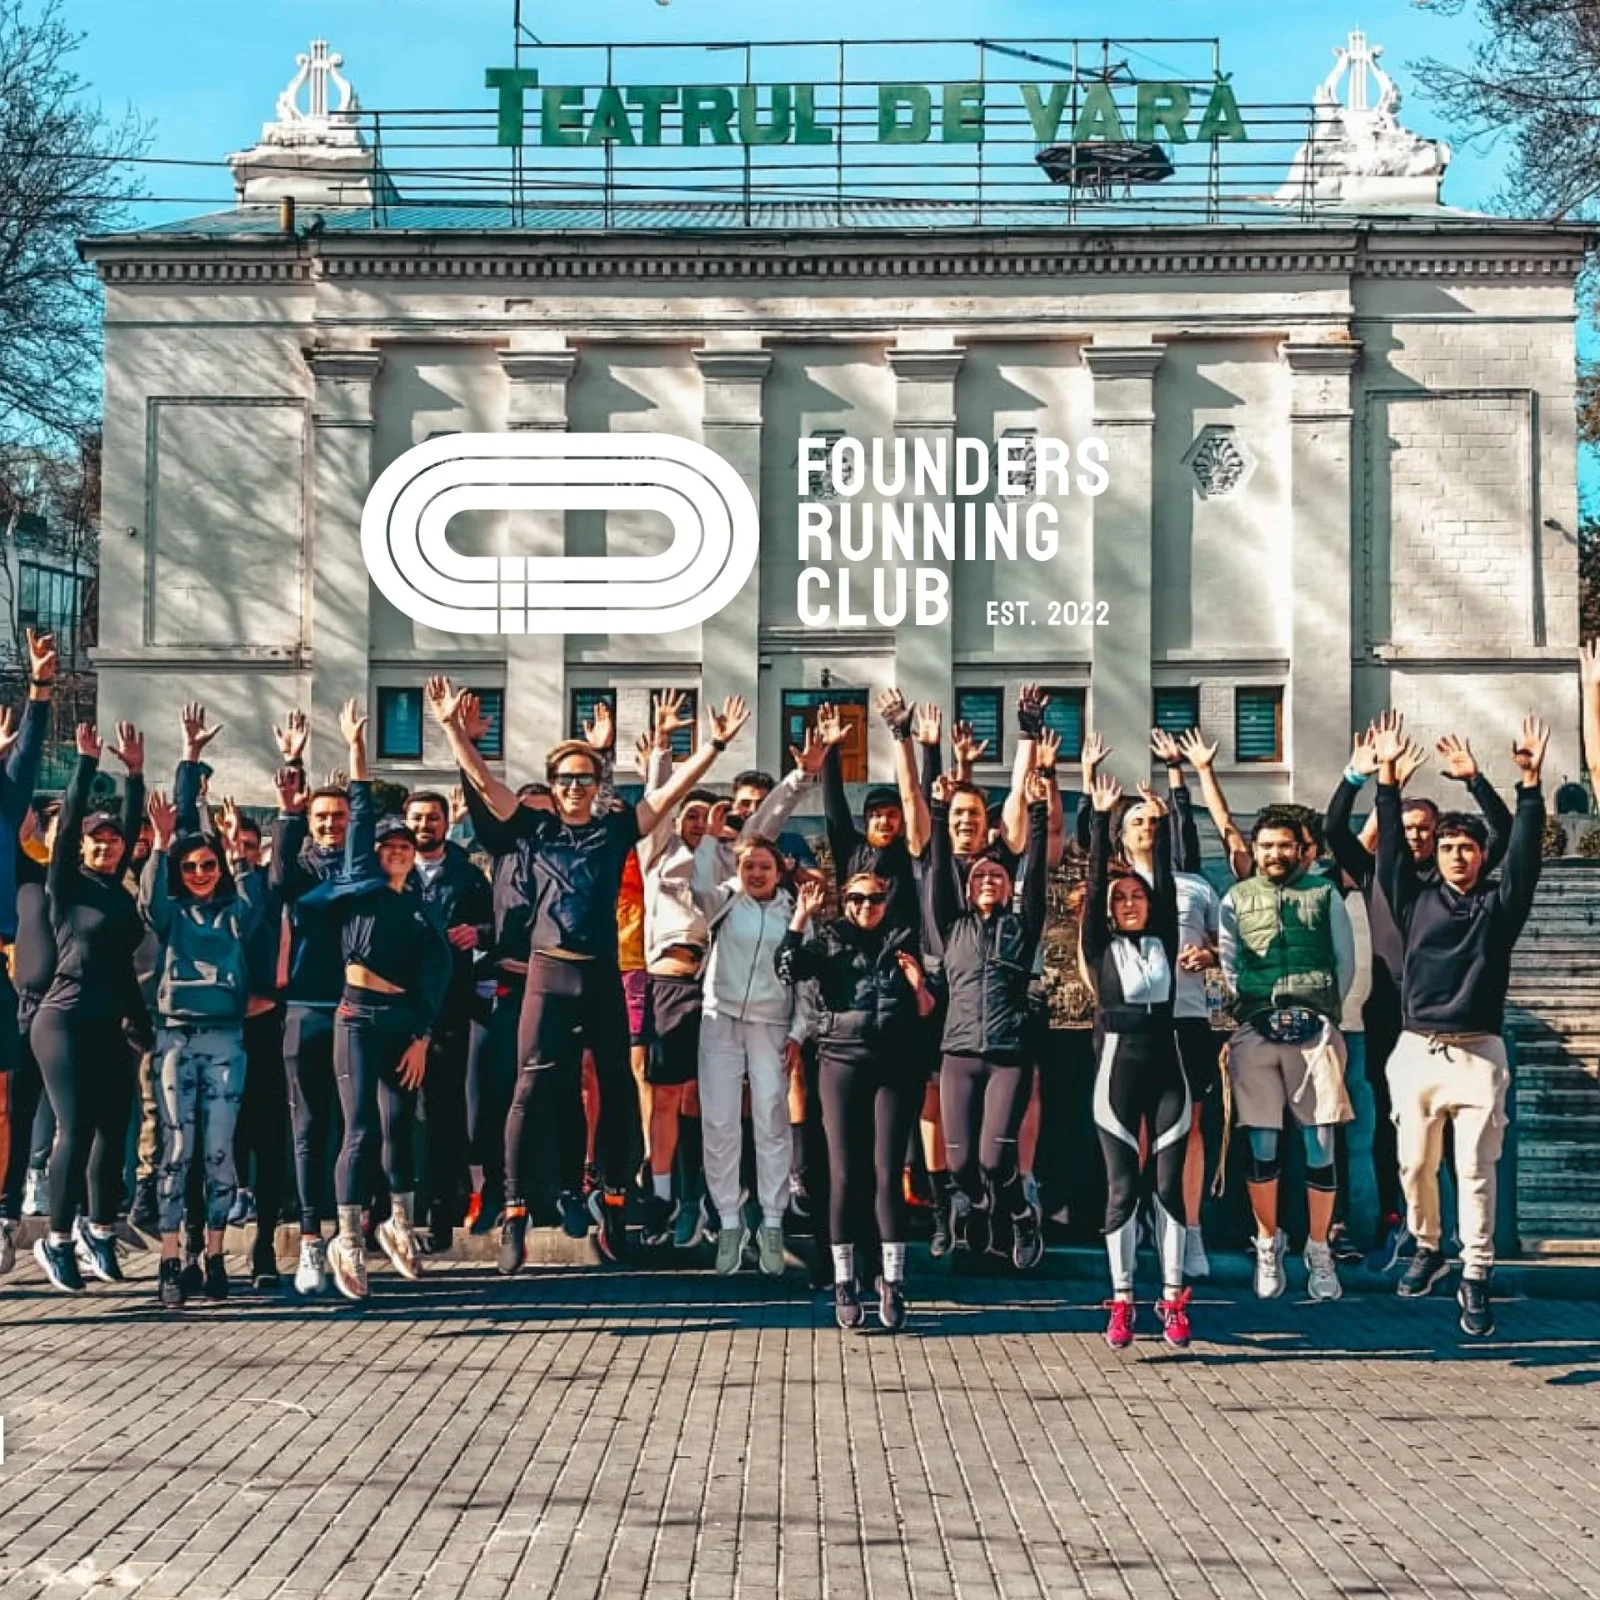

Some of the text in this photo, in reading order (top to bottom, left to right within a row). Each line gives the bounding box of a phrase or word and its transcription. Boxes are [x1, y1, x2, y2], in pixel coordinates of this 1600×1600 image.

[485, 68, 1247, 146] TEATRUL DE VARĂ
